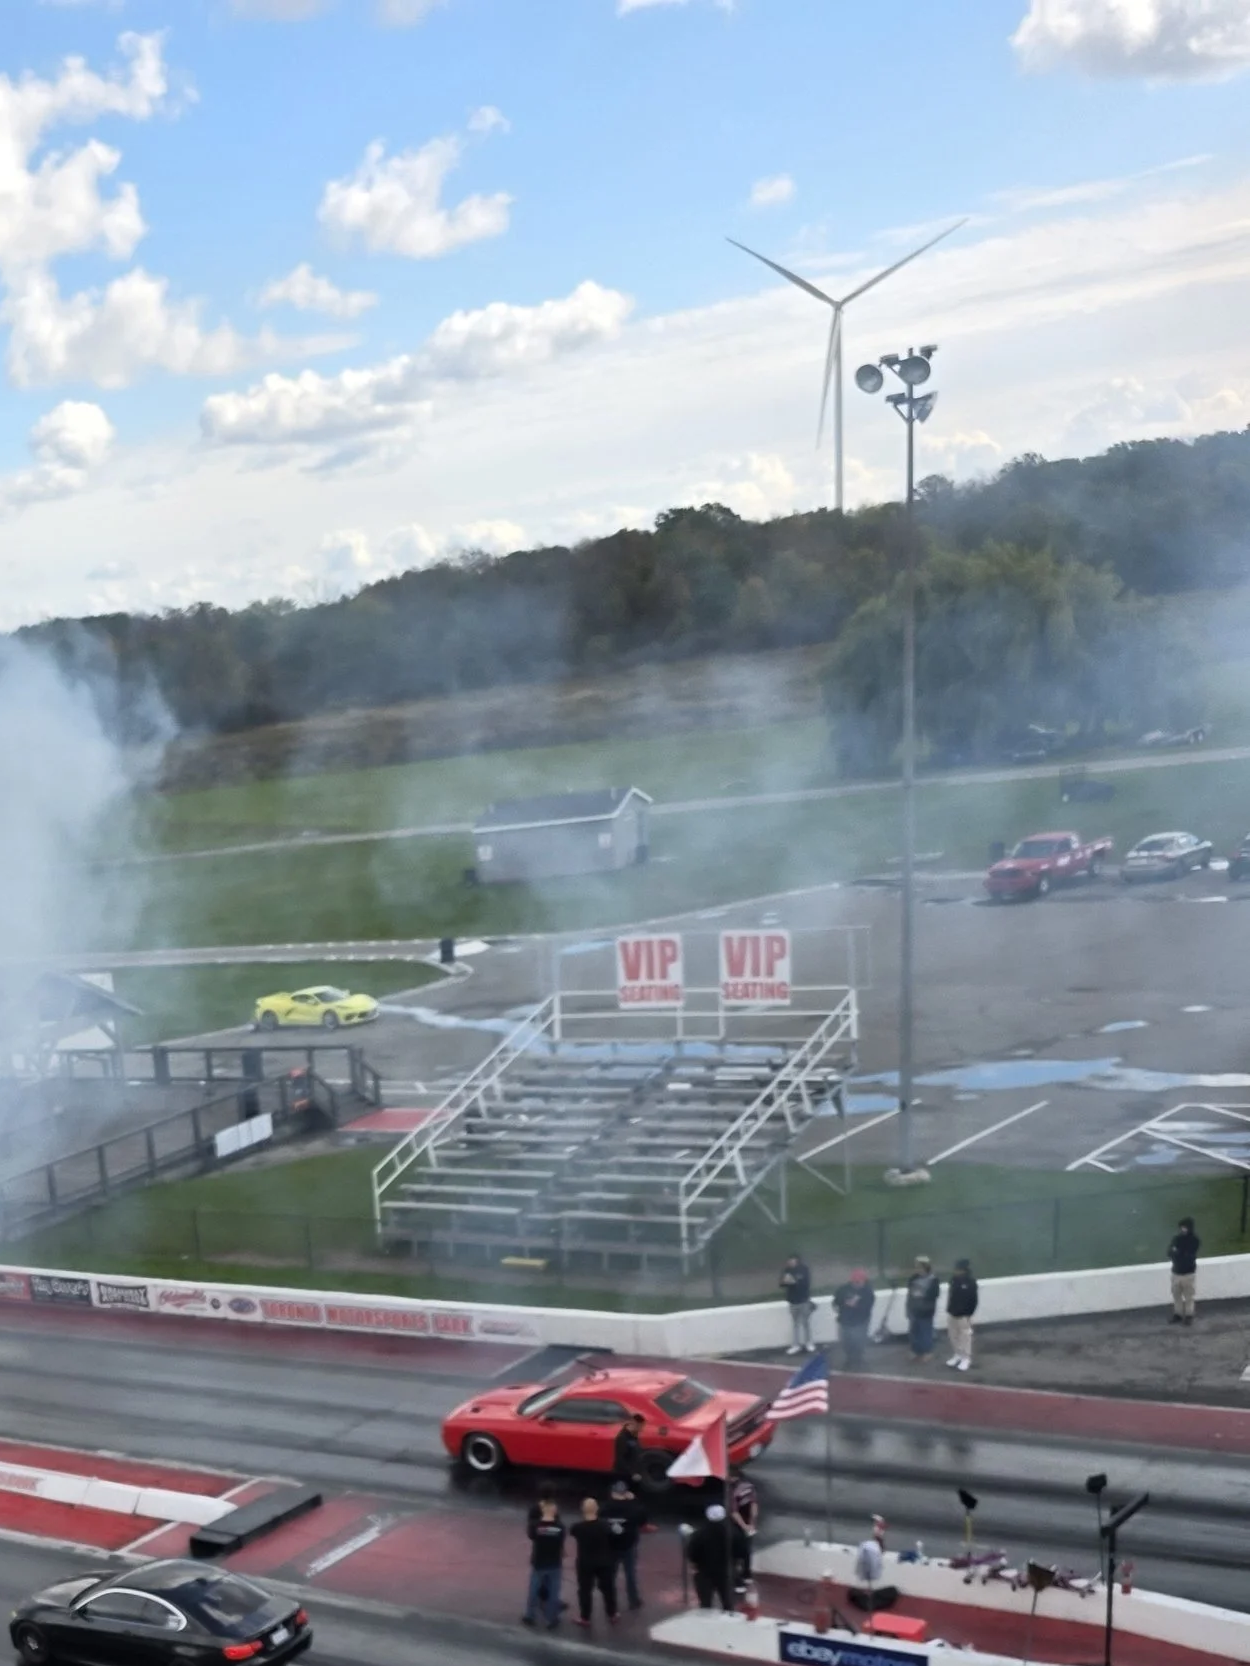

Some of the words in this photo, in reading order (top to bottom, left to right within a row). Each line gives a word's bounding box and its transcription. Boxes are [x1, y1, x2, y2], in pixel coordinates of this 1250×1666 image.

[619, 939, 678, 981] VIP
[723, 935, 786, 978] VIP
[619, 984, 681, 1002] SEATING
[721, 981, 789, 1000] SEATING
